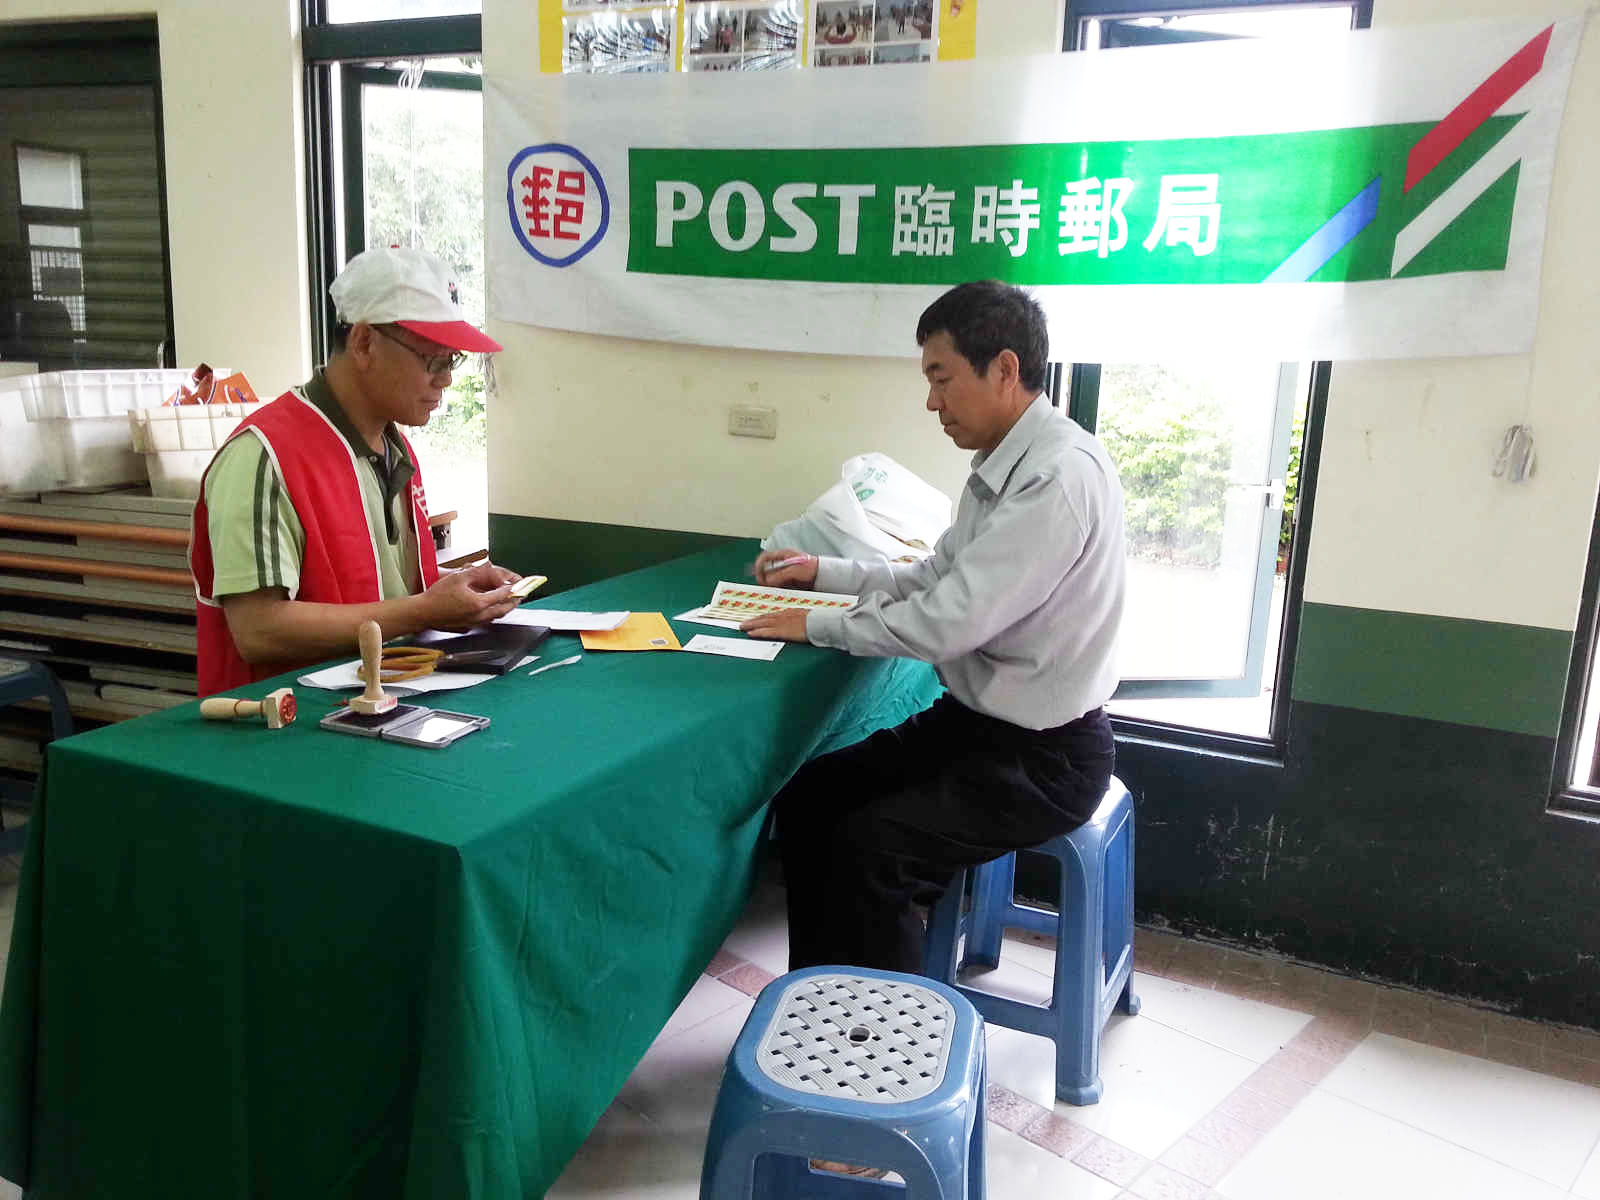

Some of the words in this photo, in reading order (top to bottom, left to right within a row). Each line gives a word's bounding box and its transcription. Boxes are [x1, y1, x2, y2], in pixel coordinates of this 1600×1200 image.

[655, 179, 877, 255] POST
[891, 173, 1222, 259] 臨時郵局
